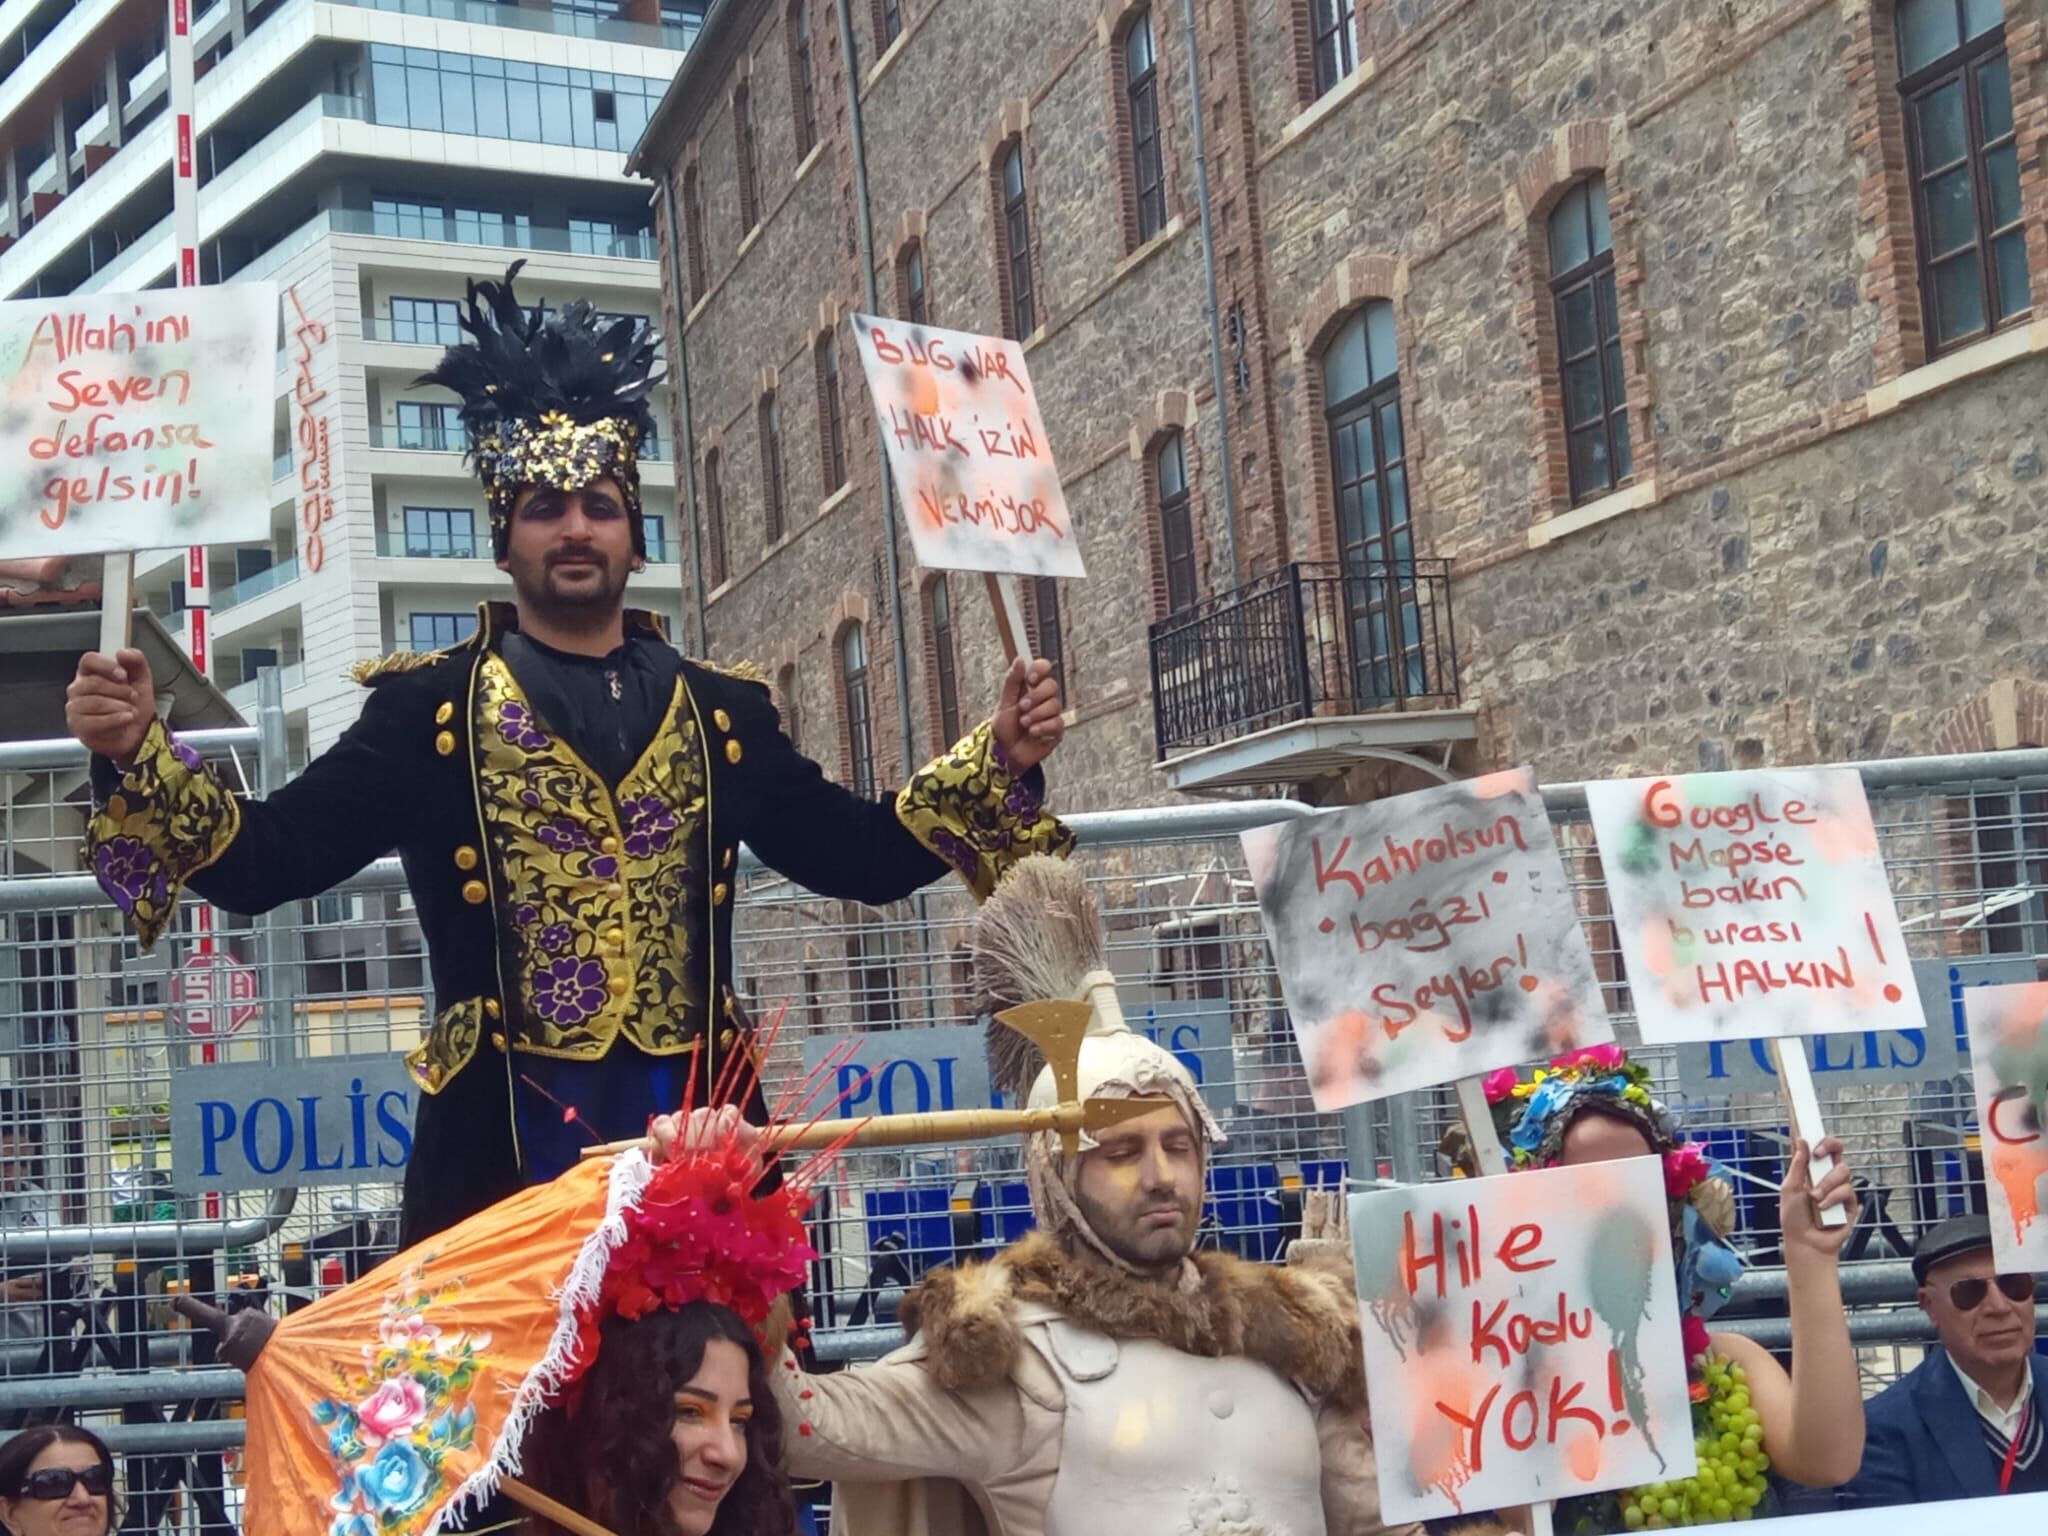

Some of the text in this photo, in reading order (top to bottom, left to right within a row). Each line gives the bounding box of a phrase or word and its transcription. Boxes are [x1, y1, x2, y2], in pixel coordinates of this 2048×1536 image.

[870, 327, 1026, 394] BUG VAR
[28, 413, 215, 460] defansa
[288, 285, 328, 574] canopy
[889, 402, 970, 458] HALK
[39, 458, 202, 530] gelsin!
[1311, 814, 1529, 901] Kahrolsun
[1668, 831, 1805, 880] Maps'e
[1680, 876, 1808, 909] bakın
[1667, 918, 1802, 946] burası
[195, 1077, 413, 1177] POLİS
[1403, 1203, 1557, 1299] Hile
[1434, 1348, 1631, 1473] YOK!
